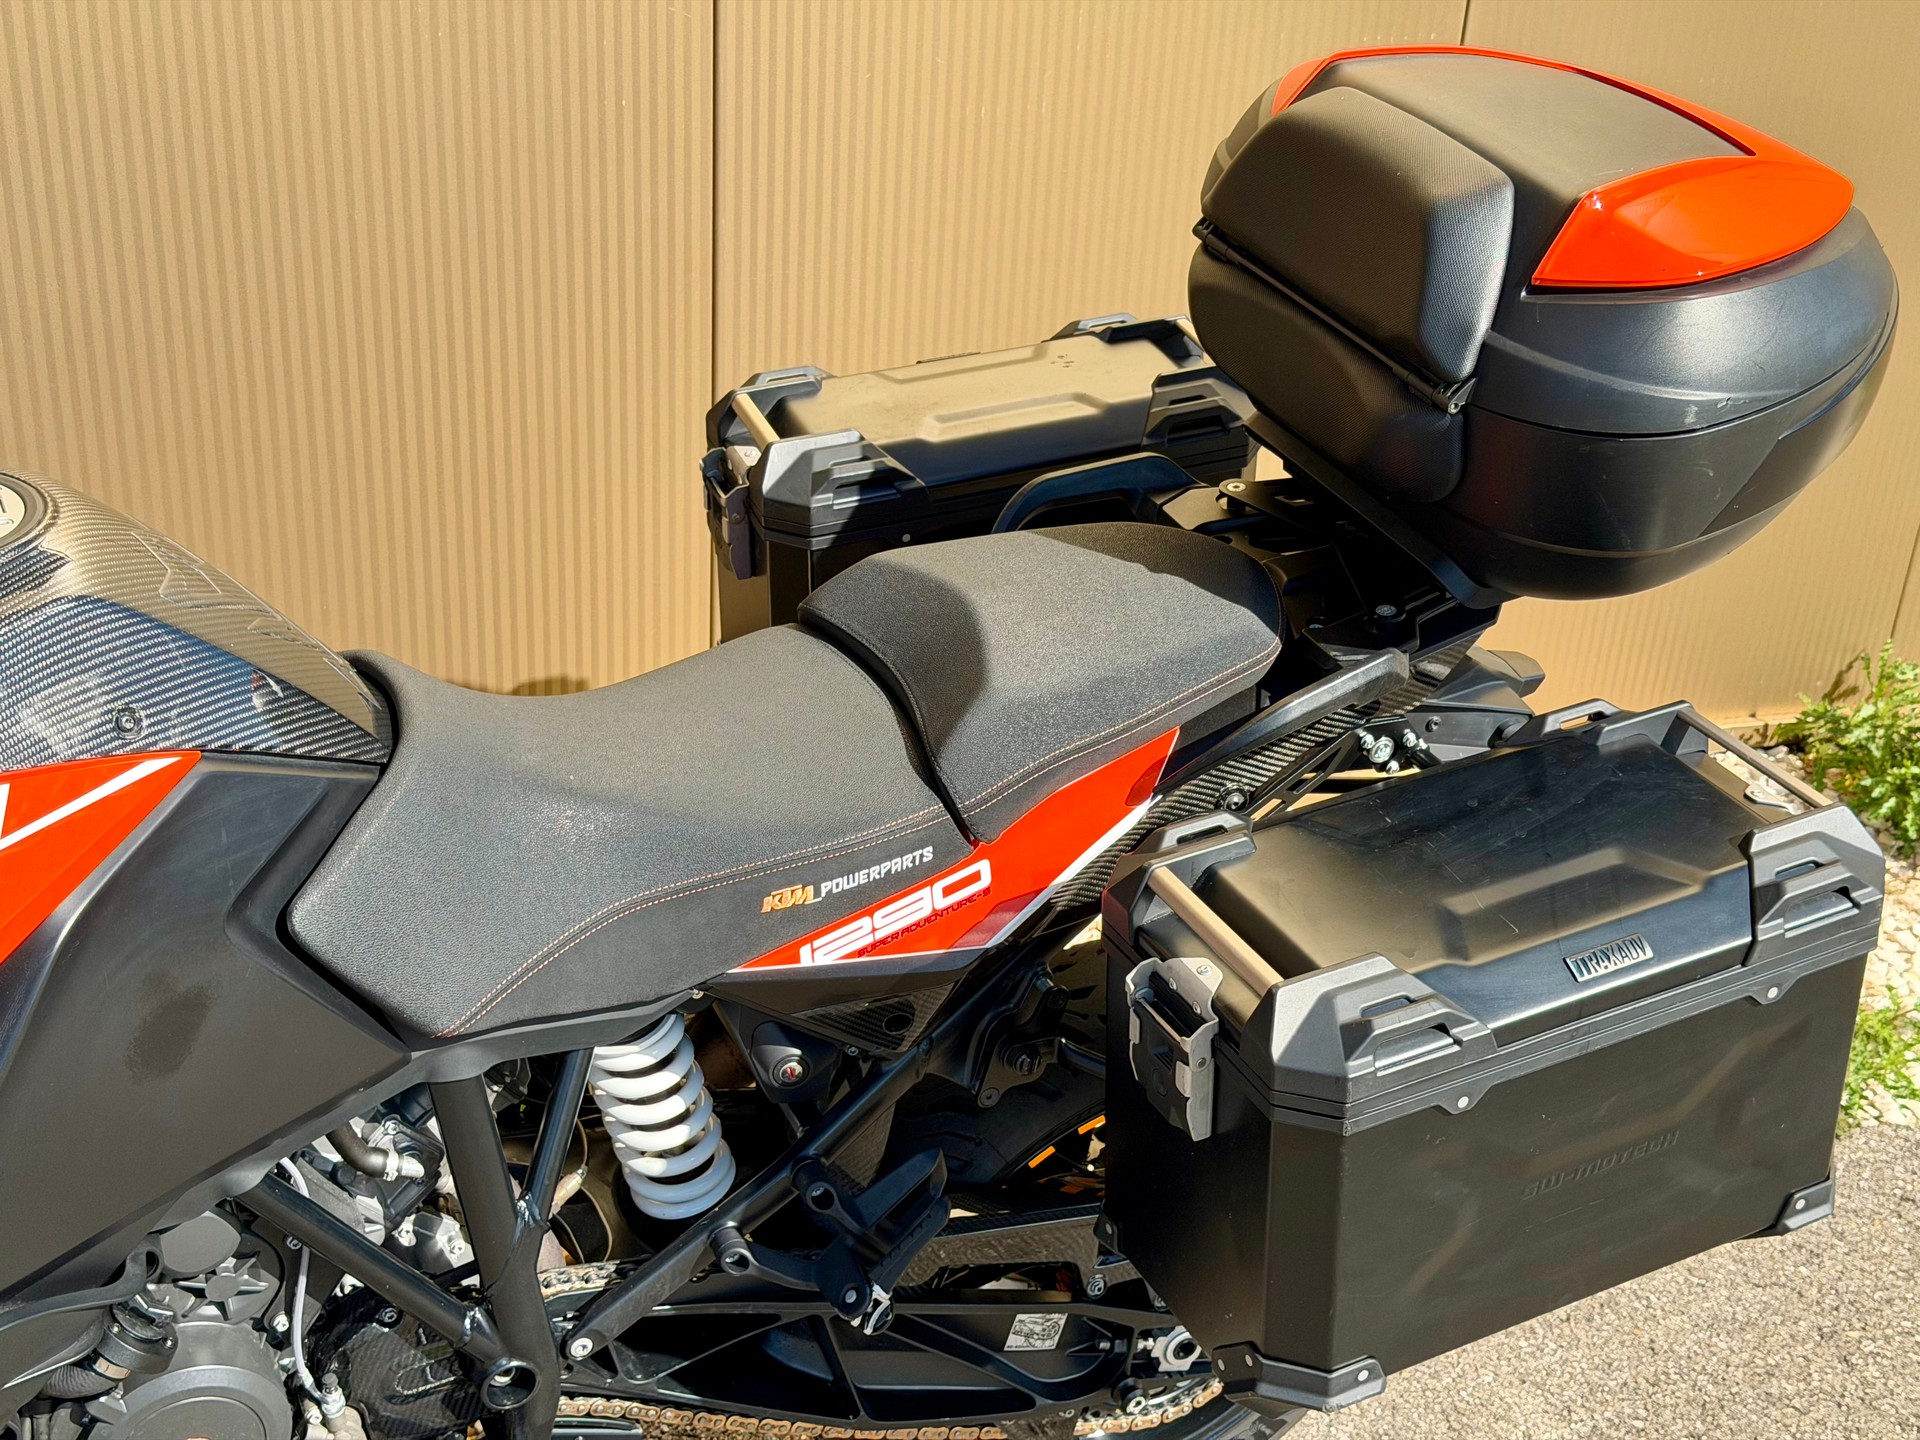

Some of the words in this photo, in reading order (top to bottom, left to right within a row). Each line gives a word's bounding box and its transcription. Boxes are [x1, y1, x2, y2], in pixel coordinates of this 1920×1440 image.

[760, 884, 815, 913] KTM
[821, 845, 934, 898] POWERPARTS
[799, 859, 991, 966] 1290
[857, 931, 900, 958] SUPER
